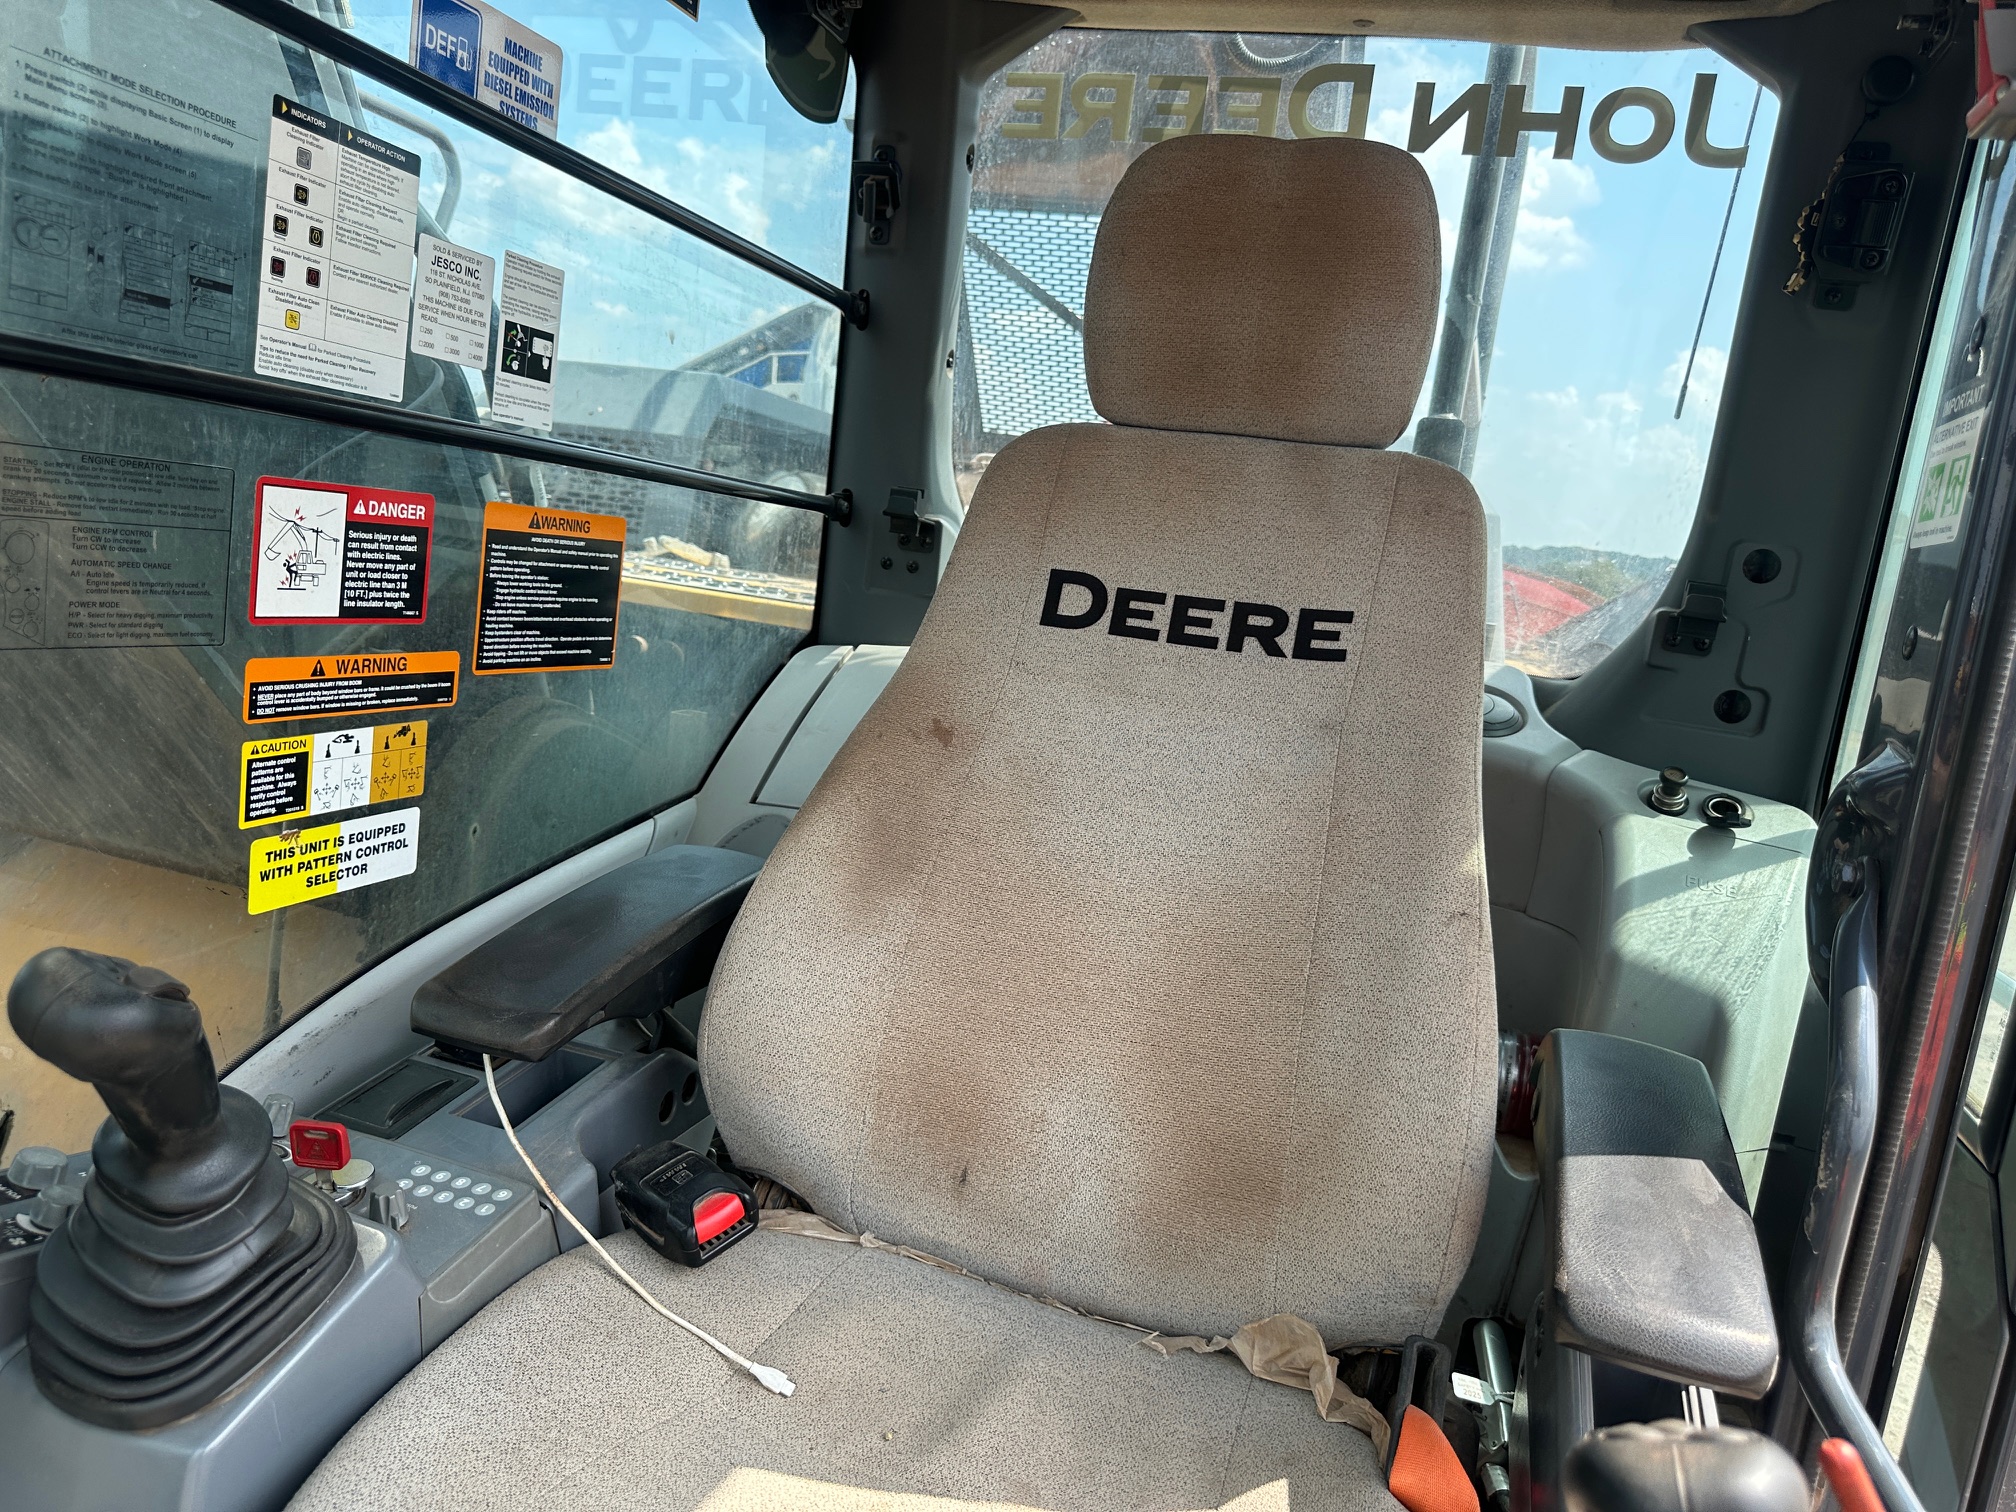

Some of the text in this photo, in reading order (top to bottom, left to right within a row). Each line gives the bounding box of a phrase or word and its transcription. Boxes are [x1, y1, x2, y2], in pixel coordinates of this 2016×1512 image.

[426, 23, 457, 58] DEF
[504, 37, 542, 72] MACHINE
[488, 51, 553, 99] EQUIPPED WITH
[43, 47, 236, 129] ATTACHMENT MODE SELECTION PROCEDURE
[484, 70, 554, 120] DIESEL EMISSION
[291, 108, 326, 130] INDICATORS
[499, 101, 538, 131] SYSTEMS
[286, 131, 324, 152] Cleaning Indicator
[291, 127, 320, 143] Exhaust Filter
[357, 136, 405, 163] OPERATOR ACTION
[433, 244, 446, 255] SOLD
[452, 251, 475, 264] SERVICED
[476, 259, 482, 267] BY
[431, 254, 482, 281] JESCO INC.
[425, 276, 432, 284] SO
[447, 274, 471, 287] NICHOLAS
[471, 282, 481, 290] AVE.
[423, 295, 433, 304] THIS
[435, 298, 457, 310] MACHINE
[463, 307, 473, 315] DUE
[474, 310, 484, 318] FOR
[418, 303, 486, 328] SERVICE WHEN HOUR METER
[421, 313, 438, 324] READS
[450, 334, 458, 342] 500
[474, 341, 484, 349] 1000
[1966, 417, 1979, 431] EXIT
[81, 454, 170, 472] ENGINE OPERATION
[368, 500, 425, 520] DANGER
[72, 526, 101, 534] ENGINE
[120, 529, 153, 538] CONTROL
[541, 516, 590, 533] WARNING
[112, 537, 141, 545] increase
[348, 530, 373, 539] Serious
[374, 532, 391, 542] injury
[400, 534, 417, 542] death
[361, 541, 379, 549] result
[347, 550, 361, 558] with
[362, 551, 385, 559] electric
[71, 559, 172, 570] AUTOMATIC SPEED CHANGE
[346, 560, 365, 568] Never
[384, 563, 395, 571] any
[396, 563, 408, 571] part
[345, 570, 358, 578] unit
[344, 590, 355, 598] [10
[355, 590, 368, 599] FT.]
[369, 591, 382, 599] plus
[384, 601, 405, 609] length.
[1040, 568, 1354, 662] DEERE
[336, 657, 407, 674] WARNING
[261, 739, 306, 753] CAUTION
[252, 756, 296, 769] Alternate control
[251, 768, 274, 778] patterns
[251, 775, 275, 785] available
[276, 773, 284, 781] for
[251, 779, 297, 793] machine. Always
[250, 789, 286, 802] verify control
[250, 799, 275, 810] response
[276, 795, 293, 804] before
[250, 805, 277, 818] operating.
[265, 822, 406, 863] THIS UNIT IS EQUIPPED
[259, 837, 408, 882] WITH PATTERN CONTROL
[306, 863, 368, 888] SELECTOR
[1686, 875, 1736, 899] FUSE
[1464, 1389, 1481, 1399] 2025
